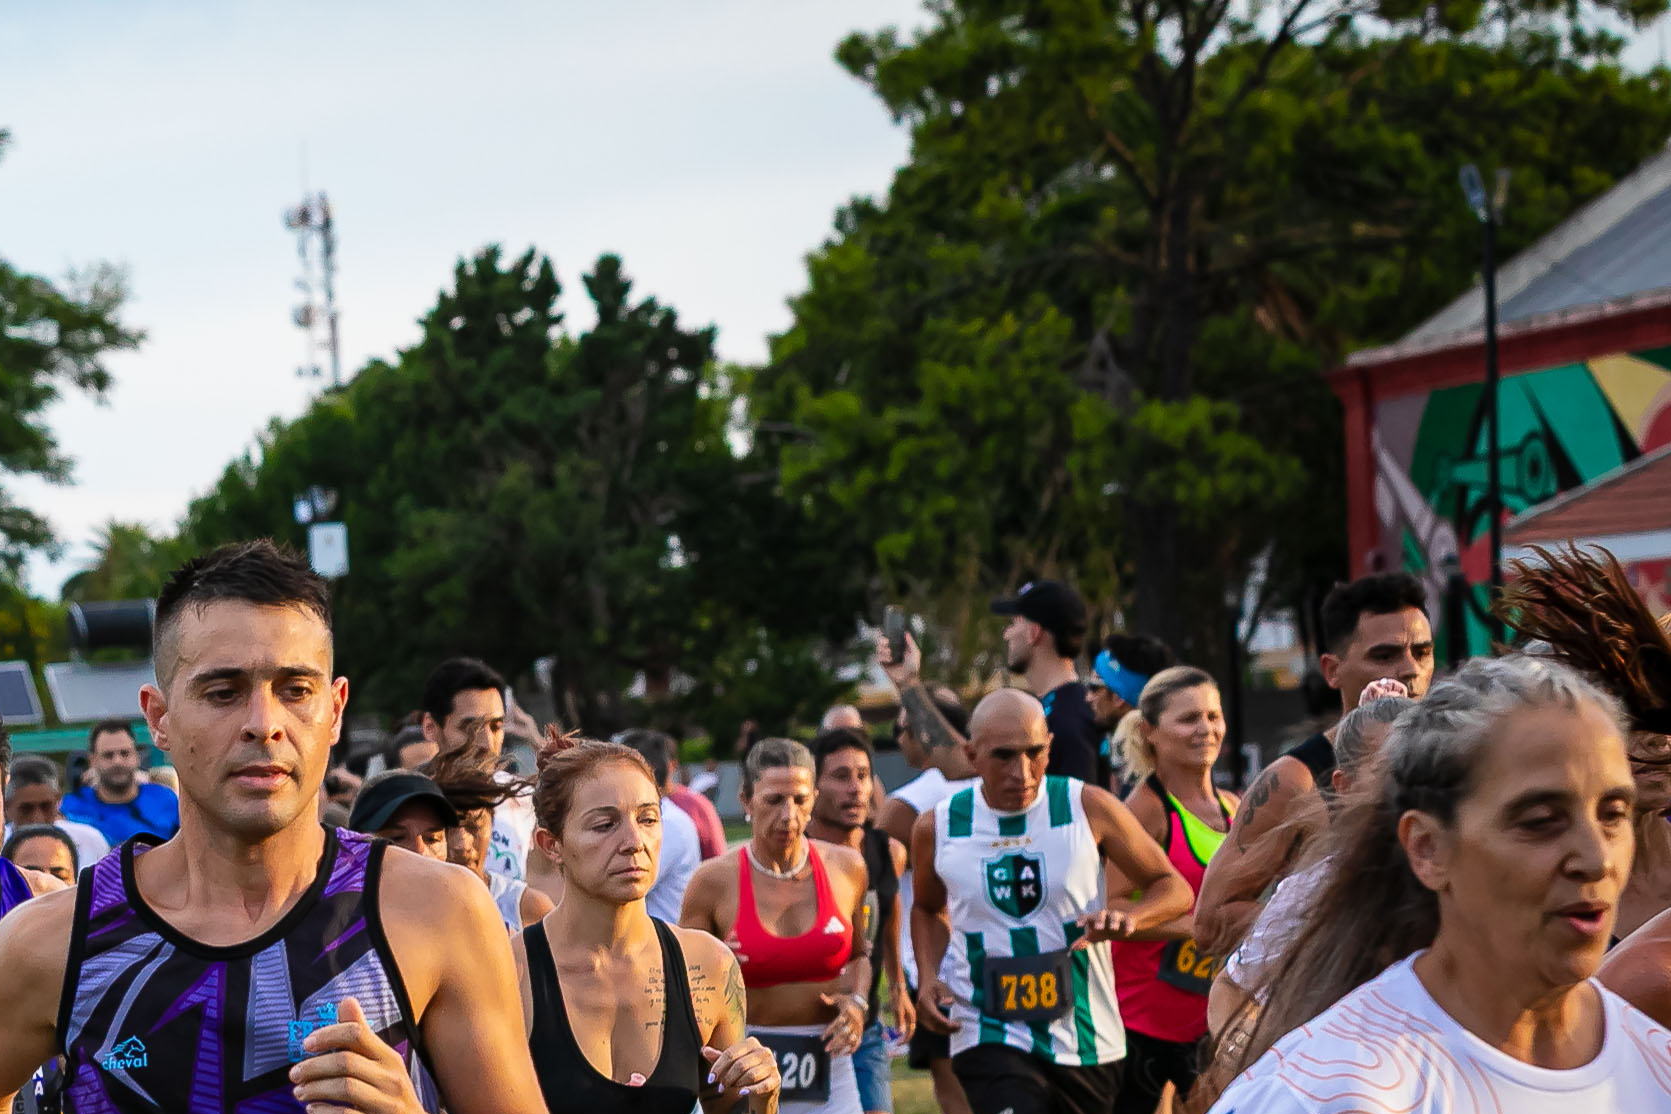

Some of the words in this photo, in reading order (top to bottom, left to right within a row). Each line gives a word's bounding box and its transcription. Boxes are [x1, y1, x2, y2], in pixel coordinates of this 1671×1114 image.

[1000, 971, 1058, 1011] 738
[101, 1053, 148, 1070] cheval
[773, 1051, 816, 1089] 20
